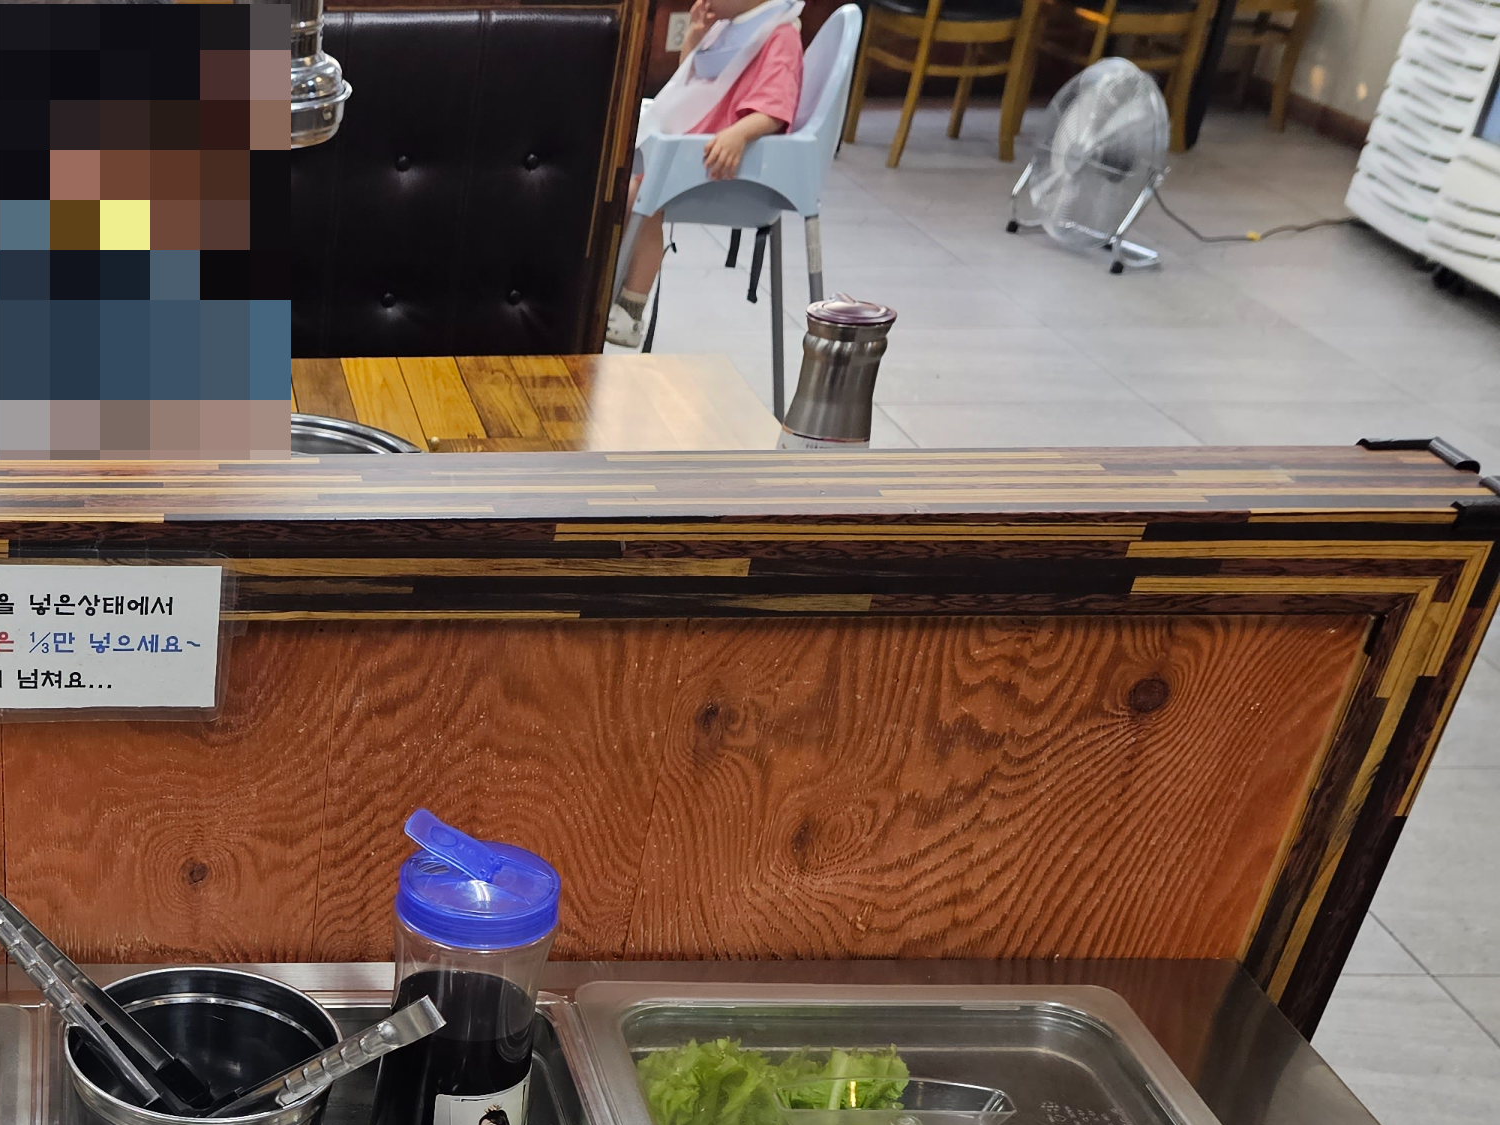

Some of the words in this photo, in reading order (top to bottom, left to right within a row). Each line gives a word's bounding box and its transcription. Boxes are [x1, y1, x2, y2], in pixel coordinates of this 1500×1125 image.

[29, 593, 174, 616] 넣은상태에서
[89, 632, 201, 654] 넣으세요~
[17, 668, 113, 690] 넘쳐요...
